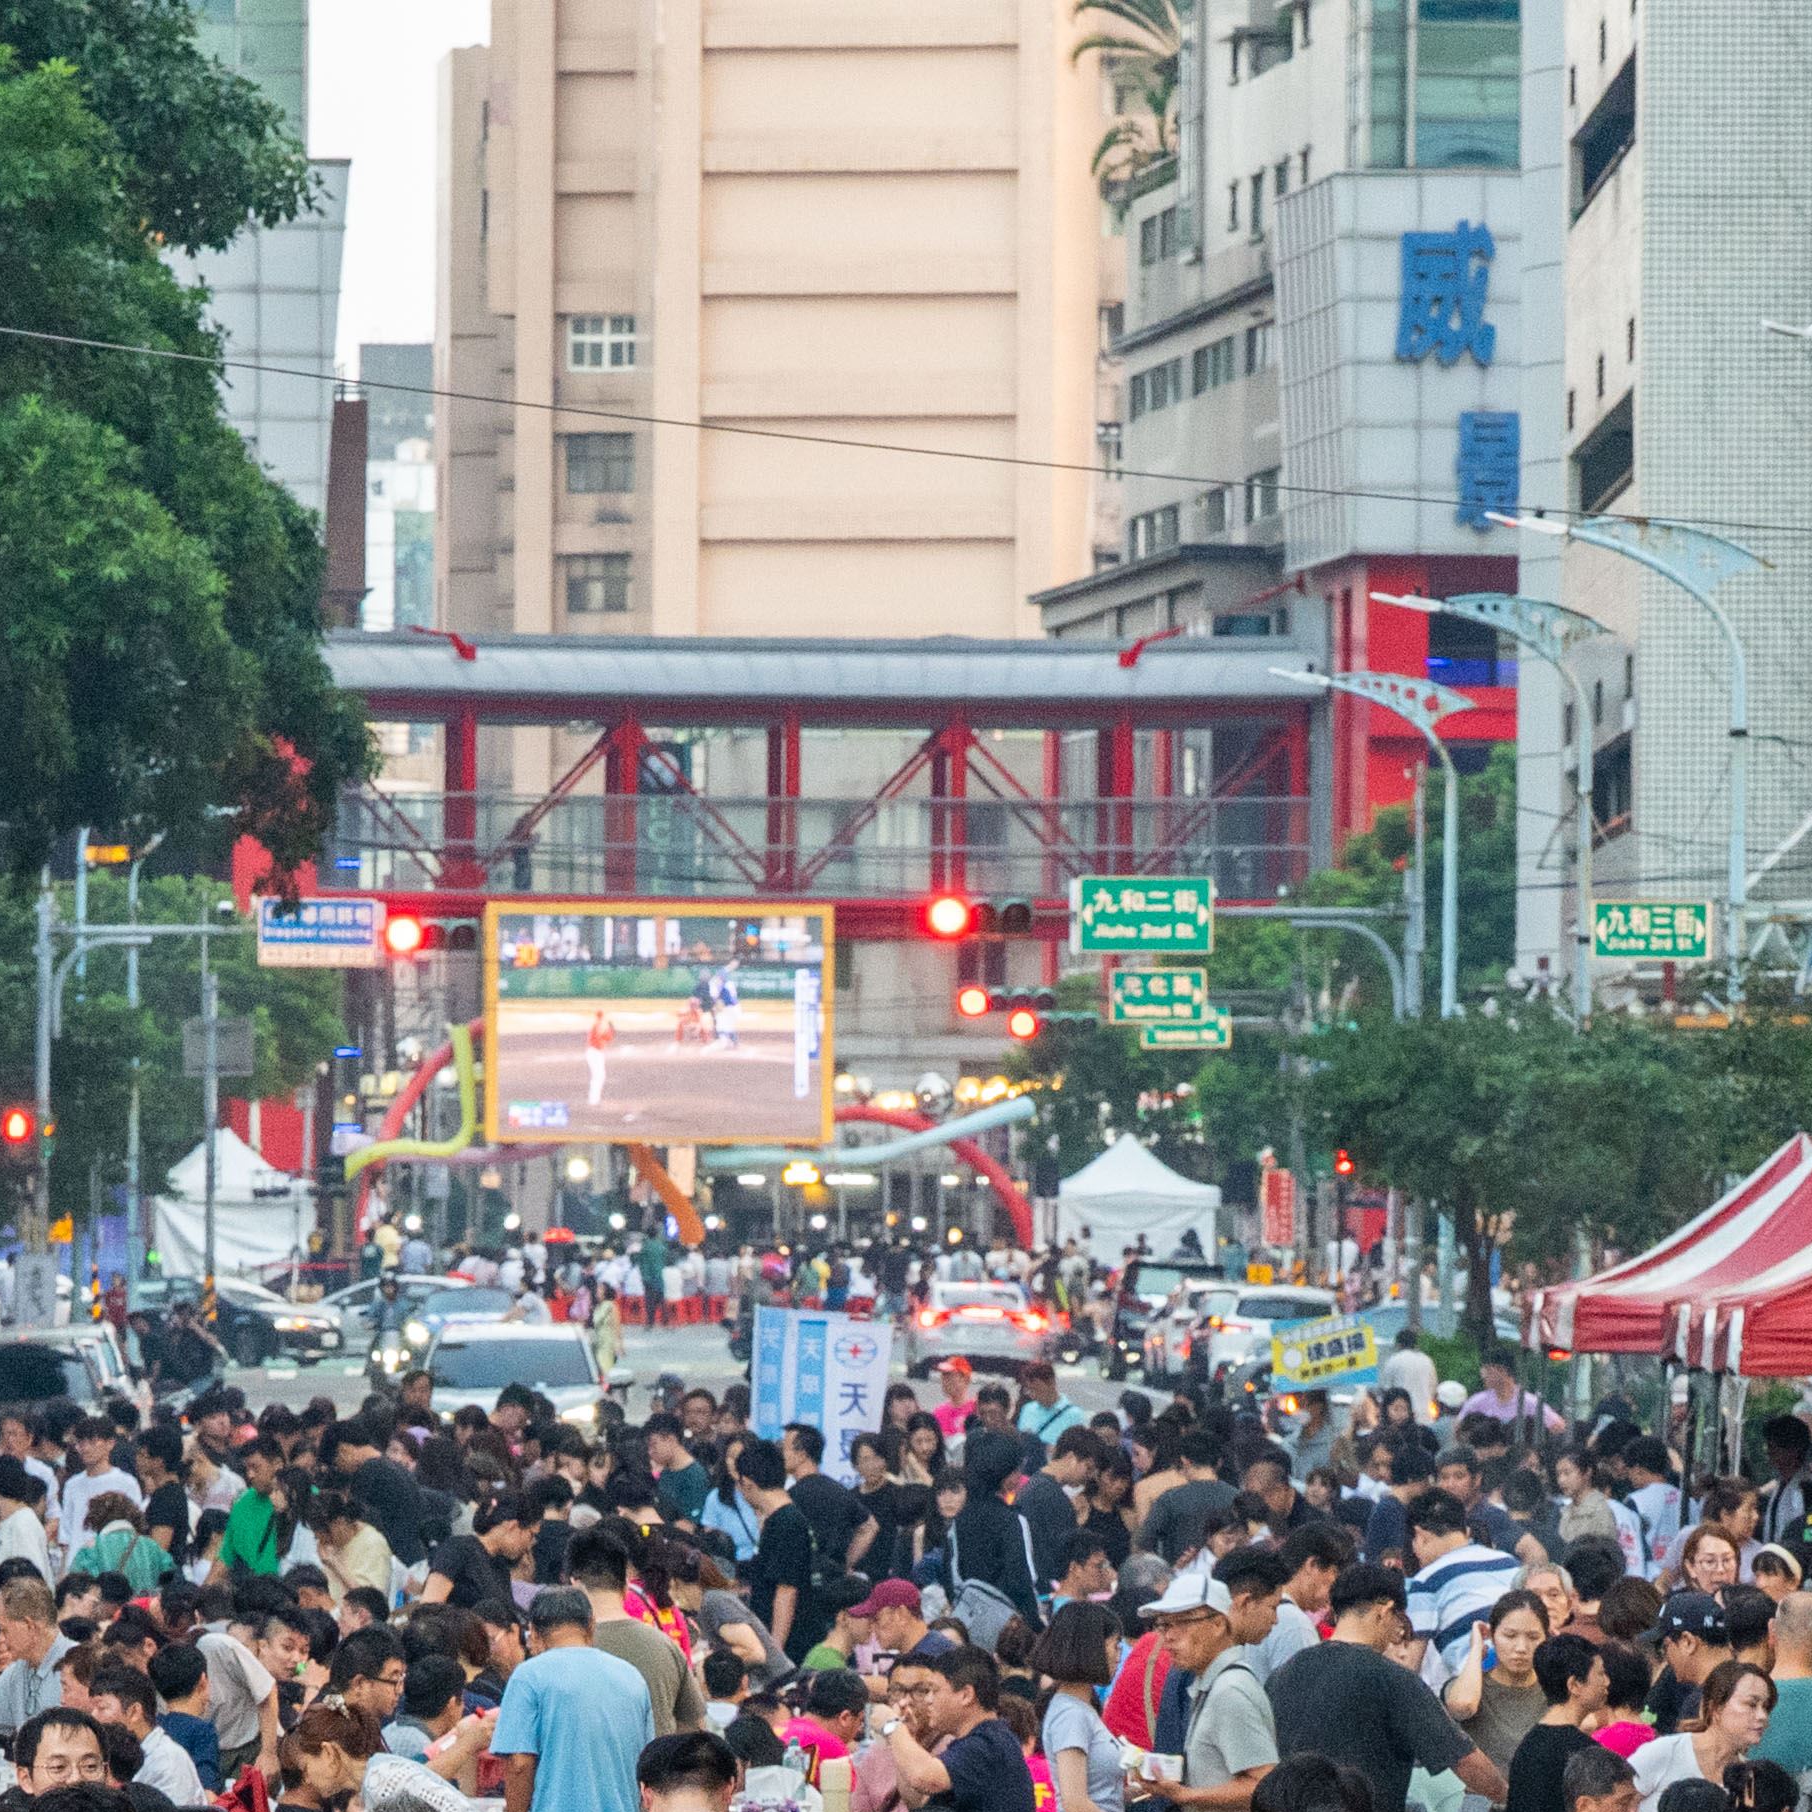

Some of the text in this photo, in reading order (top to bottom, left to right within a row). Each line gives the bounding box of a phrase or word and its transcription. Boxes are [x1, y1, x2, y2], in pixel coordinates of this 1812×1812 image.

[1393, 219, 1496, 369] 威
[1092, 887, 1198, 914] 九和二街
[1607, 906, 1696, 936] 九和三街
